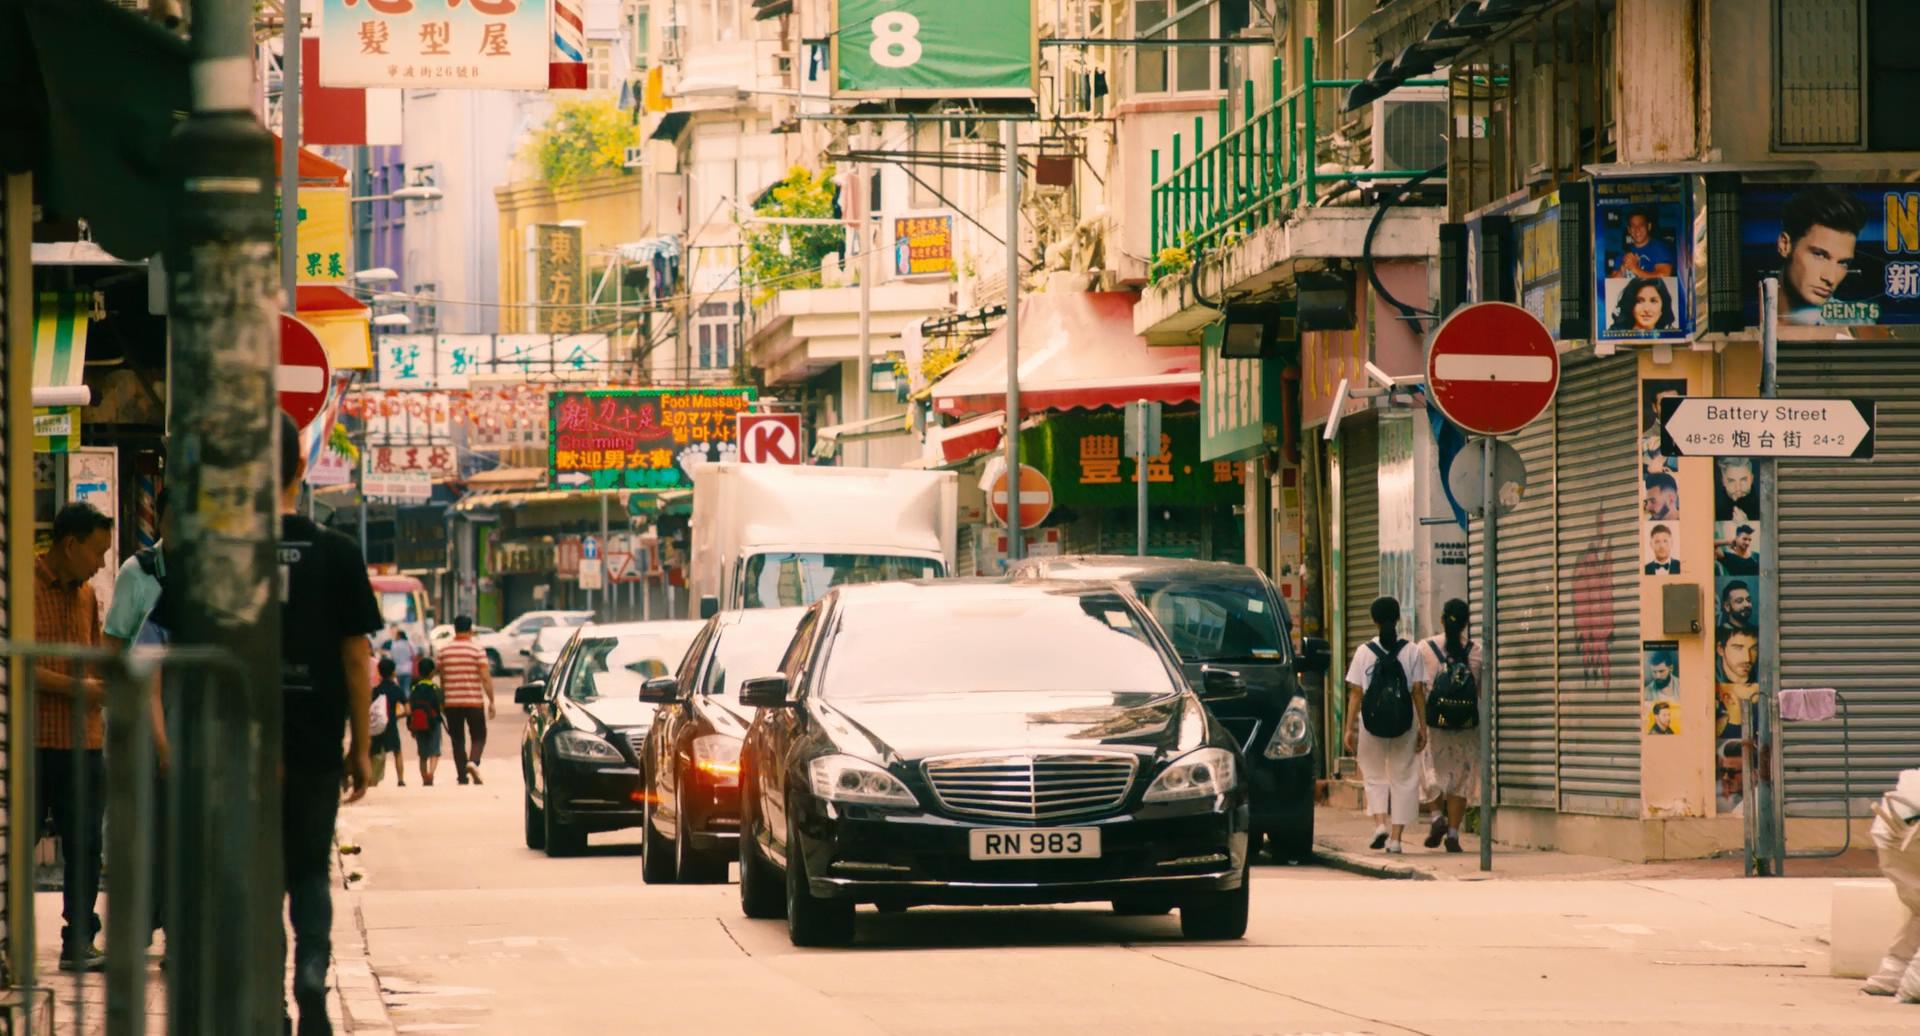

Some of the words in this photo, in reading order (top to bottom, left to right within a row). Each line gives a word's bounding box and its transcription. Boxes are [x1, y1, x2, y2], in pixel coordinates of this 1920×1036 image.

[359, 21, 511, 56] 髮型屋
[870, 11, 922, 68] 8
[1822, 302, 1880, 319] GENTS
[661, 395, 689, 409] Foot
[1707, 406, 1769, 423] Battery
[1776, 406, 1828, 421] Street
[558, 435, 635, 451] Charming
[673, 426, 737, 443] 발마사
[1685, 433, 1725, 445] 48-26
[1732, 430, 1802, 448] 炮台街
[1813, 434, 1845, 446] 24-2
[754, 426, 796, 464] K
[985, 834, 1020, 854] RN
[1030, 833, 1082, 854] 983
